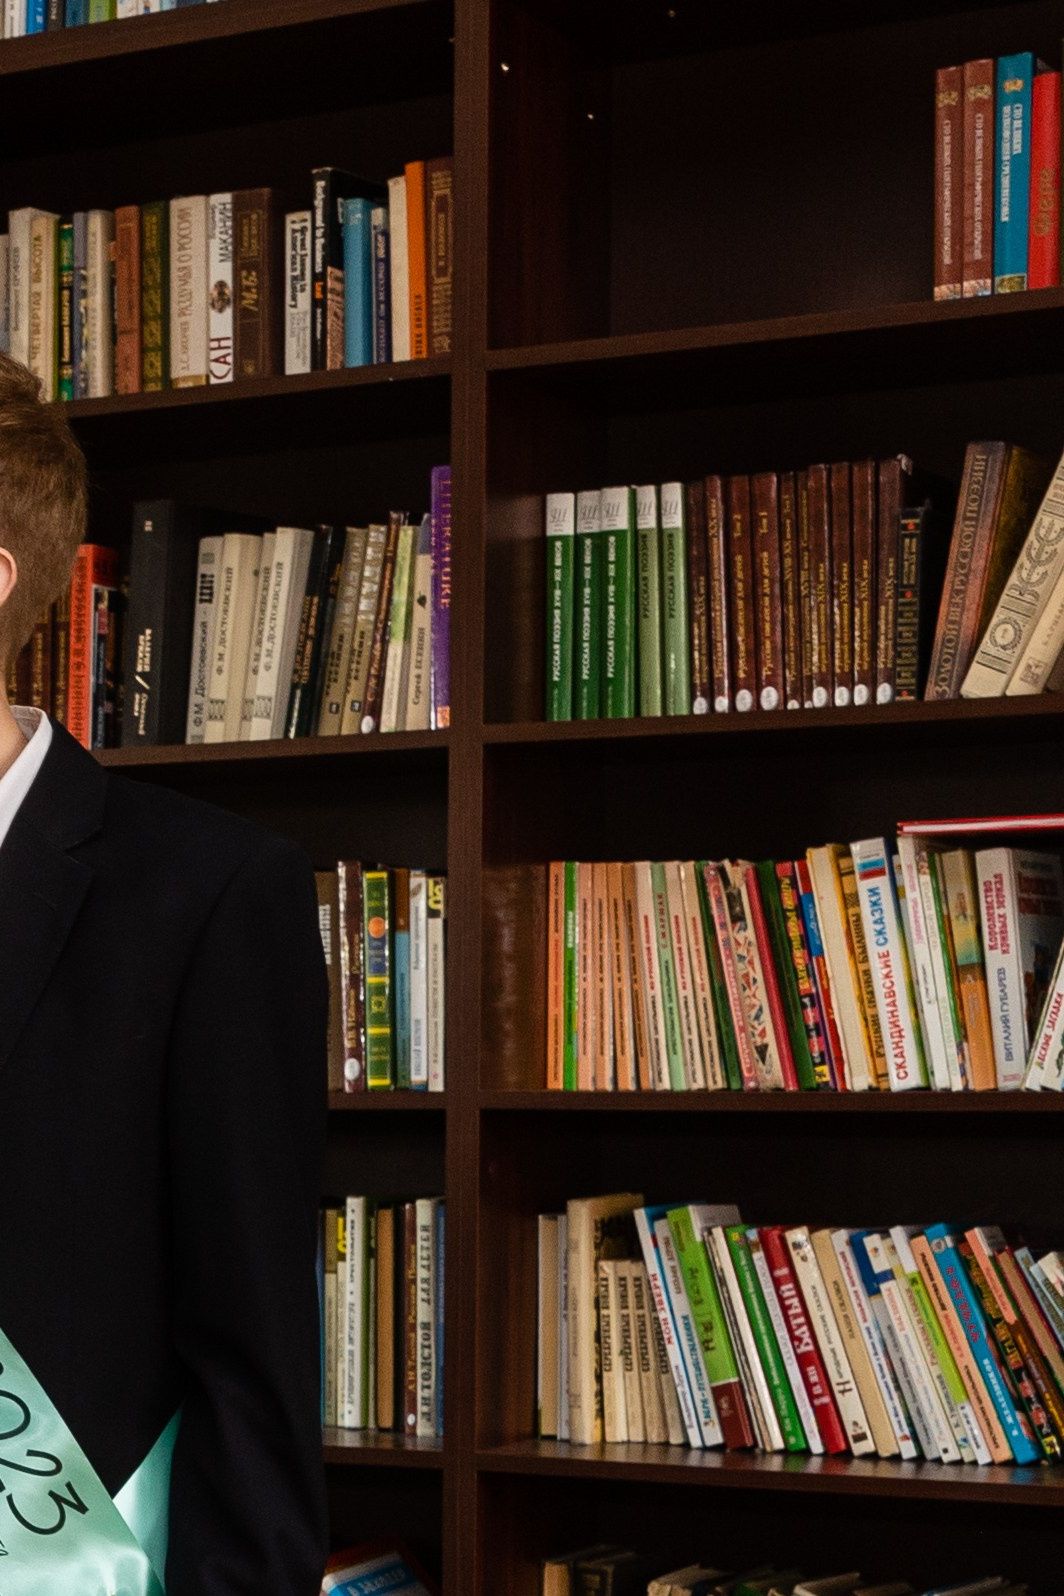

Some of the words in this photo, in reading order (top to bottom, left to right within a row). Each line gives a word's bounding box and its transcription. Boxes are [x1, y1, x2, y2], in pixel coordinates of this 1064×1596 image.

[314, 181, 325, 227] Background
[176, 206, 192, 252] РОССИИ
[218, 201, 233, 263] МАКАНИН
[290, 227, 299, 273] American
[300, 226, 308, 251] Great
[316, 228, 324, 238] to
[32, 234, 43, 284] ВЫСОТА
[177, 253, 191, 262] О
[315, 238, 325, 273] Business
[177, 265, 193, 317] РАЗДУМЬЯ
[290, 274, 298, 309] History
[31, 291, 42, 360] ЧЕТВЕРТАЯ
[210, 336, 232, 380] САН
[964, 454, 988, 517] ПОЭЗИИ
[638, 533, 648, 573] ПОЭЗИЯ
[667, 533, 676, 572] ПОЭЗИЯ
[954, 520, 979, 590] РУССКОЙ
[640, 575, 649, 619] РУССКАЯ
[668, 575, 676, 619] РУССКАЯ
[948, 593, 964, 620] ВЕК
[553, 609, 562, 642] ПОЭЗИЯ
[582, 607, 592, 641] ПОЭЗИЯ
[607, 605, 616, 638] ПОЭЗИЯ
[194, 620, 209, 698] Достоевский
[553, 644, 562, 681] РУССКАЯ
[582, 642, 592, 680] РУССКАЯ
[607, 640, 616, 678] РУССКАЯ
[934, 623, 961, 695] ЗОЛОТОЙ
[866, 886, 889, 946] СКАЗКИ
[850, 913, 868, 966] БЫЛИНЫ
[997, 967, 1012, 1013] ГУБАРЕВ
[878, 950, 909, 1082] СКАНДИНАВСКИЕ
[1000, 1013, 1014, 1062] ВИТАЛИЙ
[419, 1225, 430, 1272] ДЕТЕЙ
[420, 1276, 432, 1306] ДЛЯ
[650, 1273, 667, 1314] ЗВЕРИ
[810, 1284, 824, 1312] СКАЗКИ
[779, 1283, 816, 1356] БАТЫЙ
[820, 1314, 834, 1345] РУССКИЕ
[420, 1320, 432, 1390] ТОЛСТОЙ
[828, 1347, 852, 1397] НАРОДНЫЕ
